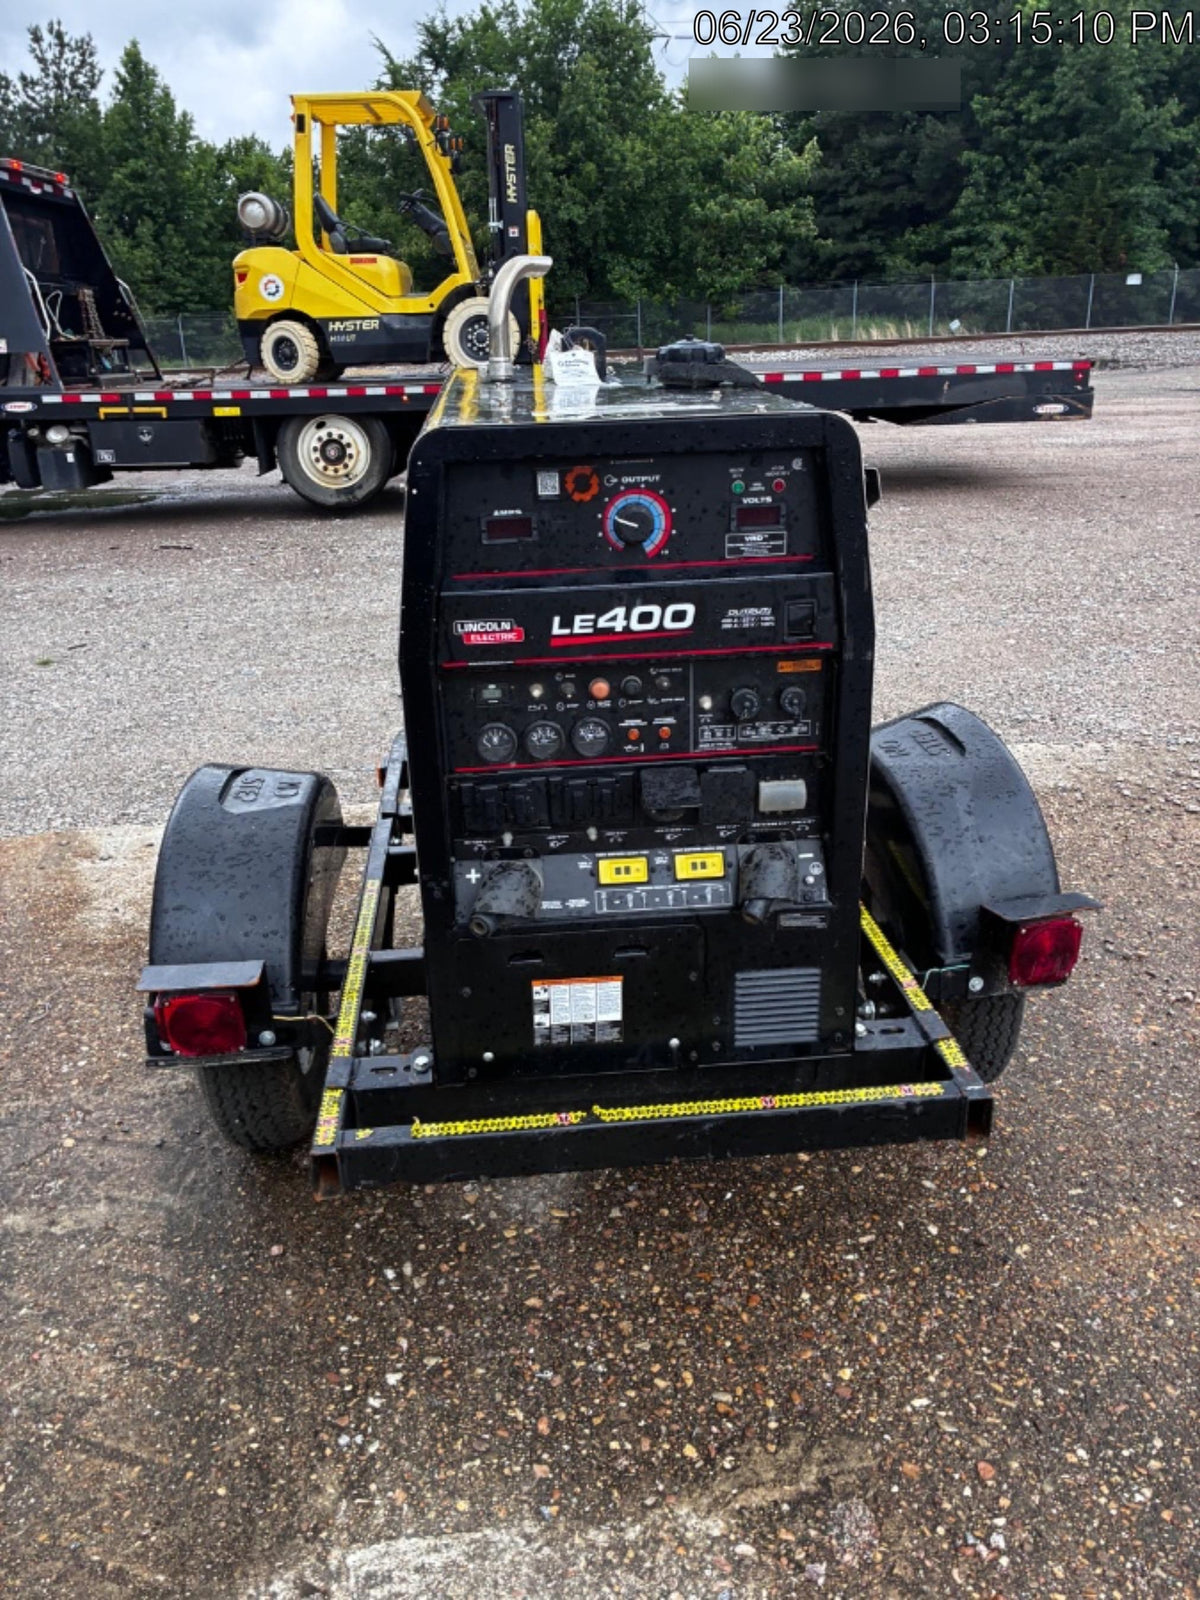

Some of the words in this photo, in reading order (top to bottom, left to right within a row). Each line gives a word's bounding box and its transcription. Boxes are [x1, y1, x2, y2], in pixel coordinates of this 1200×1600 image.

[504, 143, 518, 204] HYSTER
[328, 319, 380, 332] HYSTER
[621, 474, 661, 484] OUTPUT
[742, 495, 772, 504] VOLTS
[551, 603, 696, 636] LE400
[457, 621, 512, 633] LINCOLN
[469, 631, 517, 642] ELECTRIC
